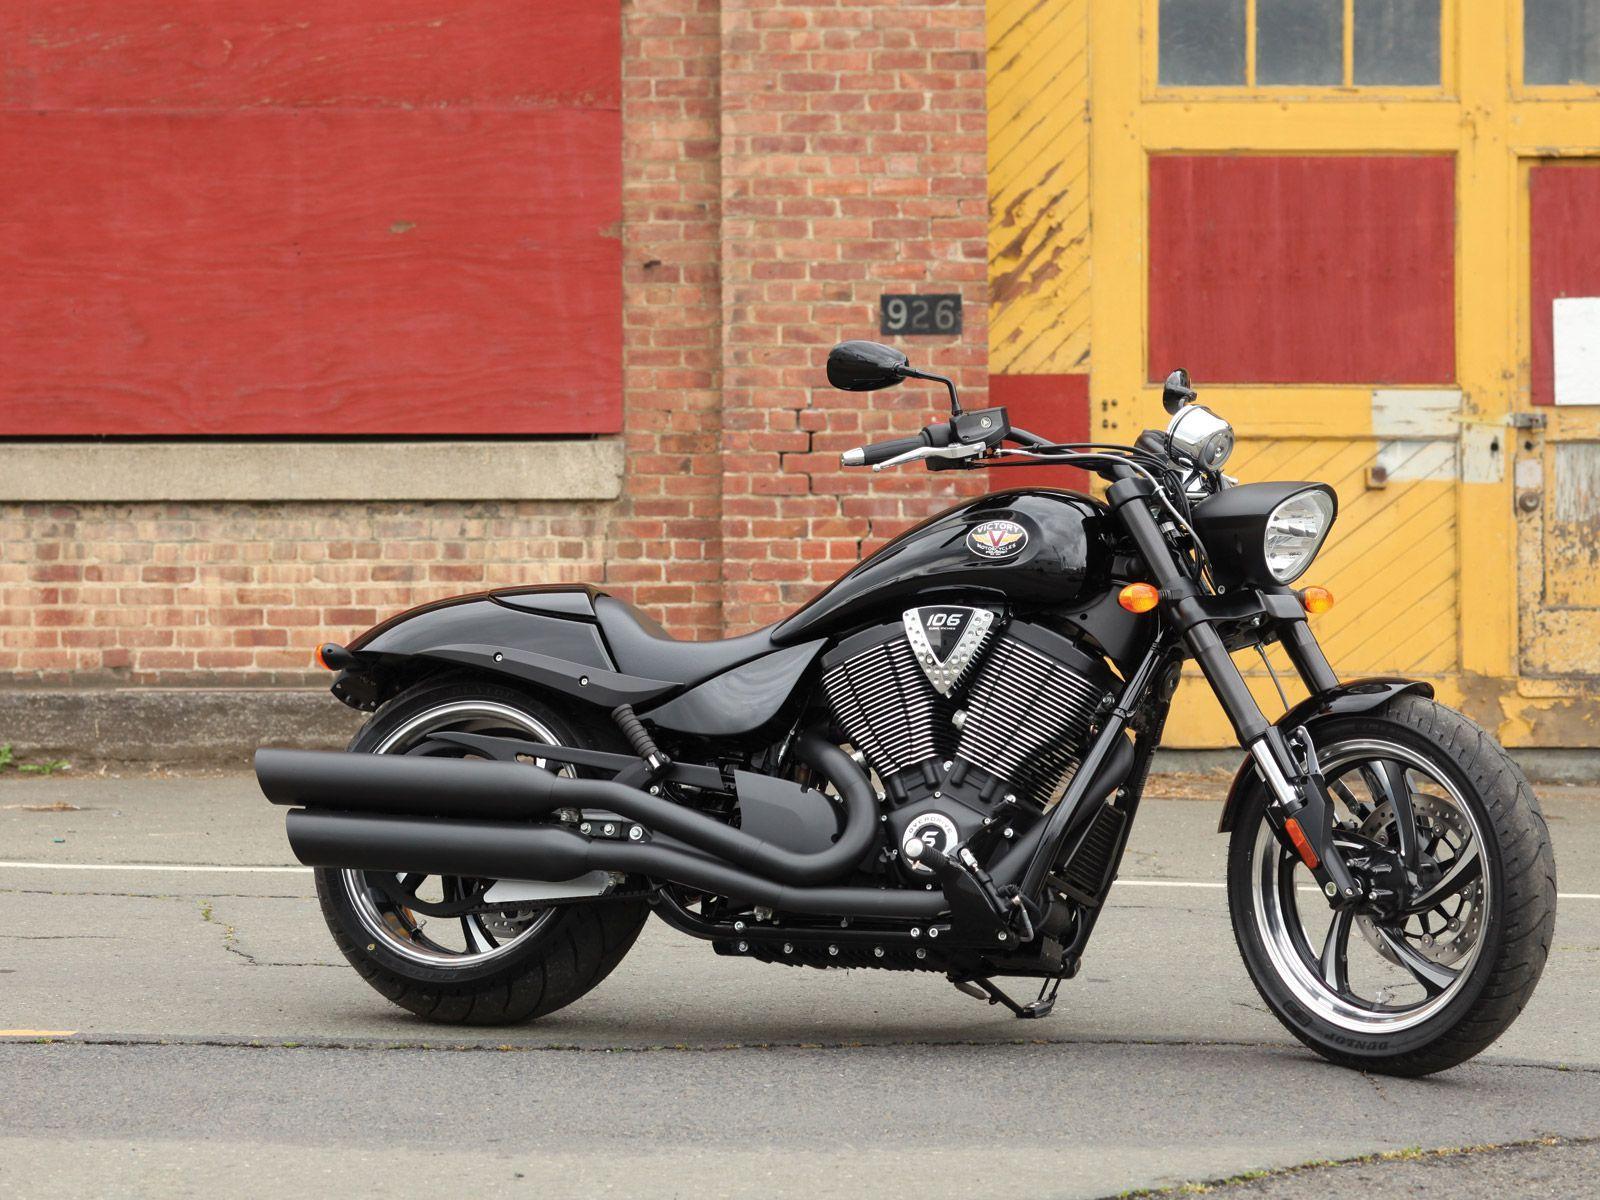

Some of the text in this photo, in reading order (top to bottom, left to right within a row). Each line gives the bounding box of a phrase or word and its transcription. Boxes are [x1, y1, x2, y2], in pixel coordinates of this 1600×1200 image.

[886, 298, 955, 330] 926
[977, 522, 1020, 533] VICTORY
[926, 613, 964, 627] 106
[908, 816, 953, 834] OVERDRIVE
[1323, 1032, 1389, 1050] DUNLOP
